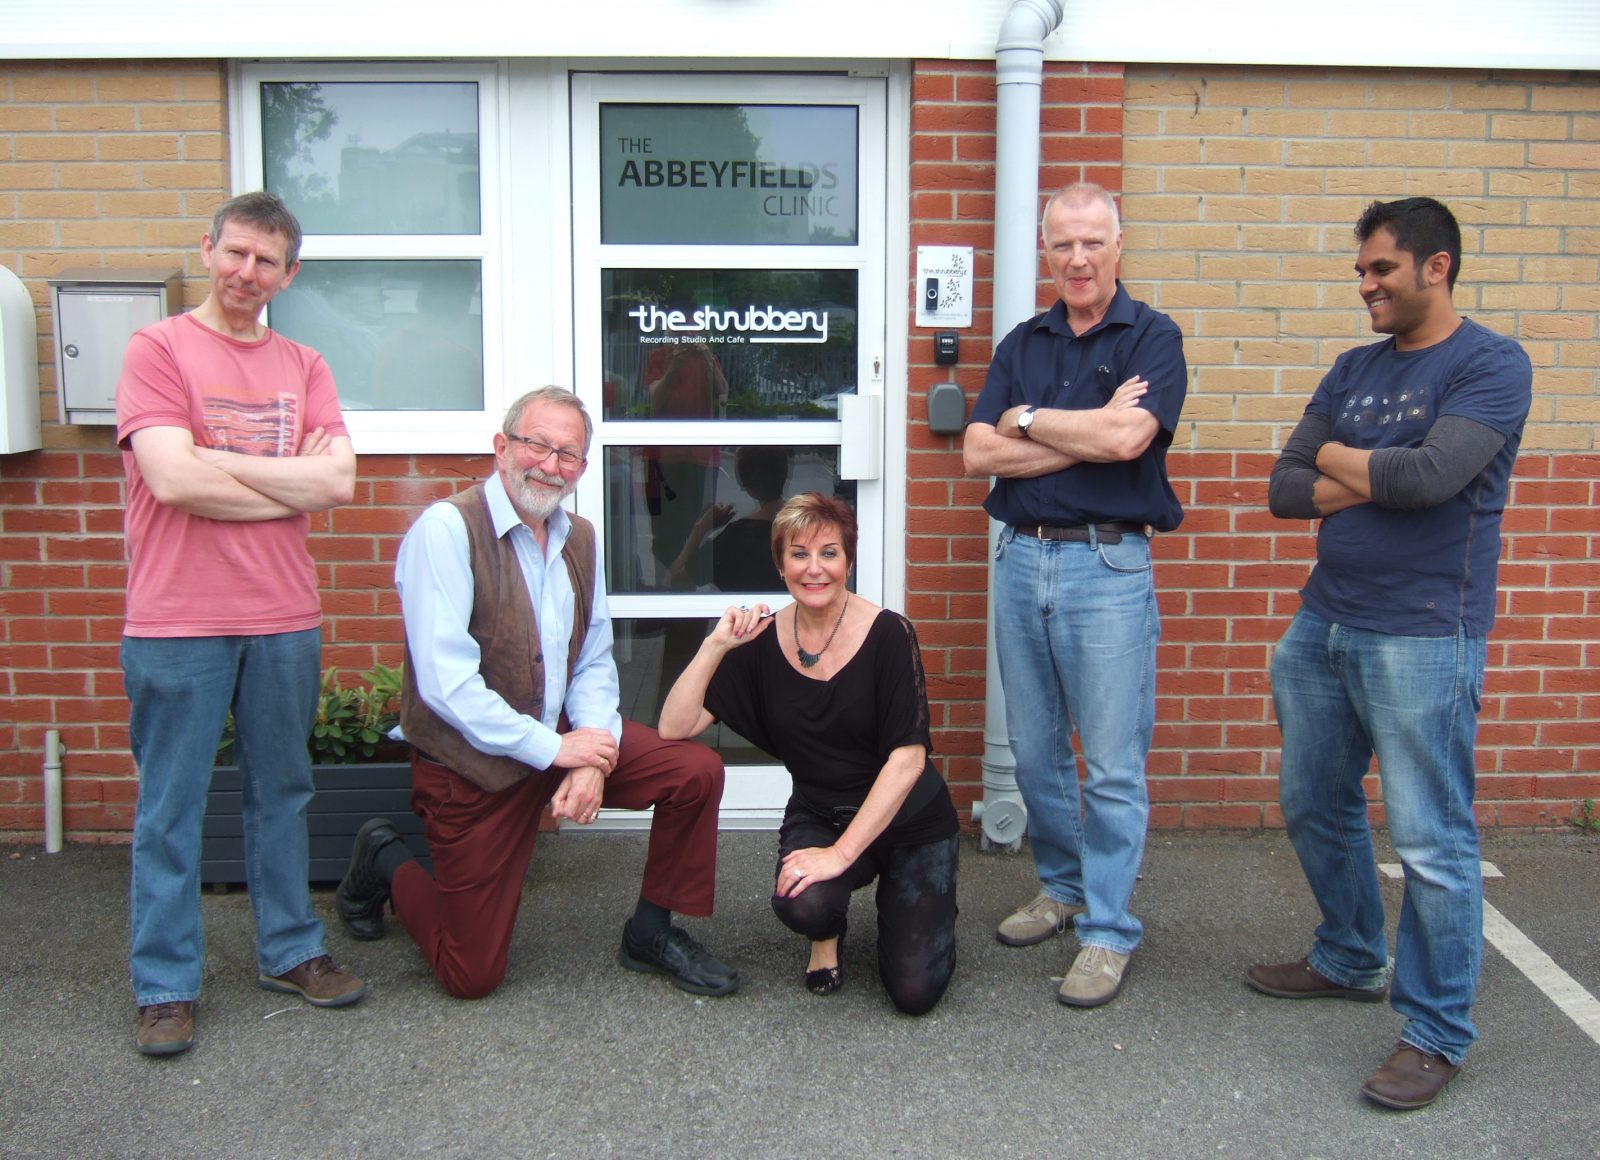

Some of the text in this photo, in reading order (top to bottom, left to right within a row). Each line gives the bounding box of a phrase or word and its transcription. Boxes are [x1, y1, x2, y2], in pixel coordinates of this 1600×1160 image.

[617, 137, 653, 153] THE
[618, 160, 839, 189] ABBEYFIELDS
[763, 195, 840, 217] CLINIC
[628, 305, 828, 343] the shrubbery
[640, 335, 745, 345] Recording Studio And Cafe
